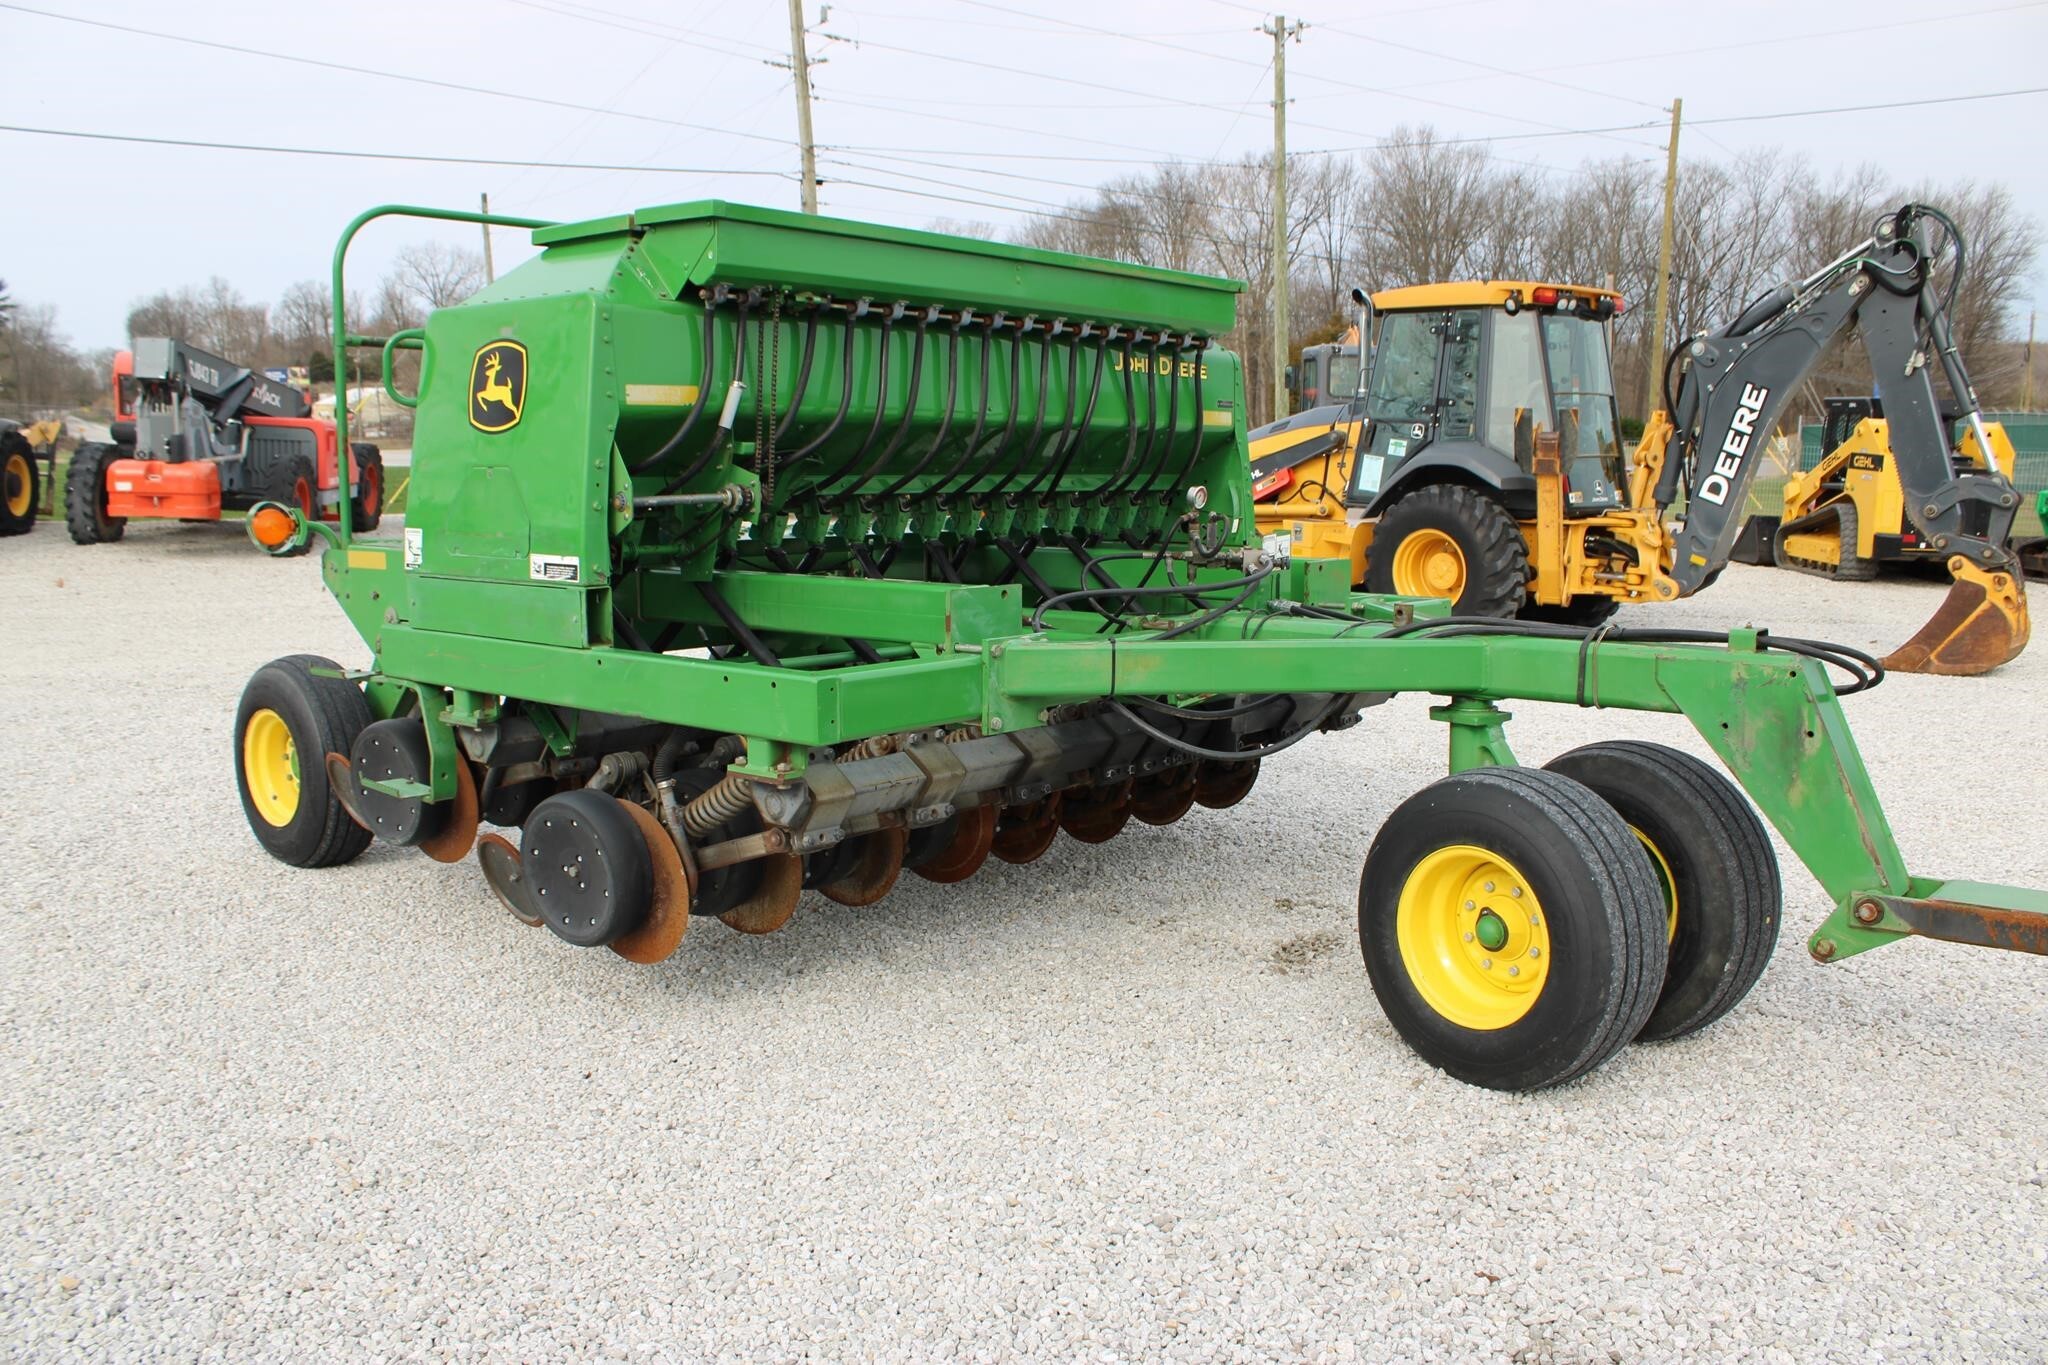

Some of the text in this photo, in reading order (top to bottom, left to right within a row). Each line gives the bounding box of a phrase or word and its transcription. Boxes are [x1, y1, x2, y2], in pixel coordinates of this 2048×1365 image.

[1698, 382, 1769, 506] DEERE
[1822, 452, 1842, 471] GEHL
[1853, 455, 1875, 469] GEHL
